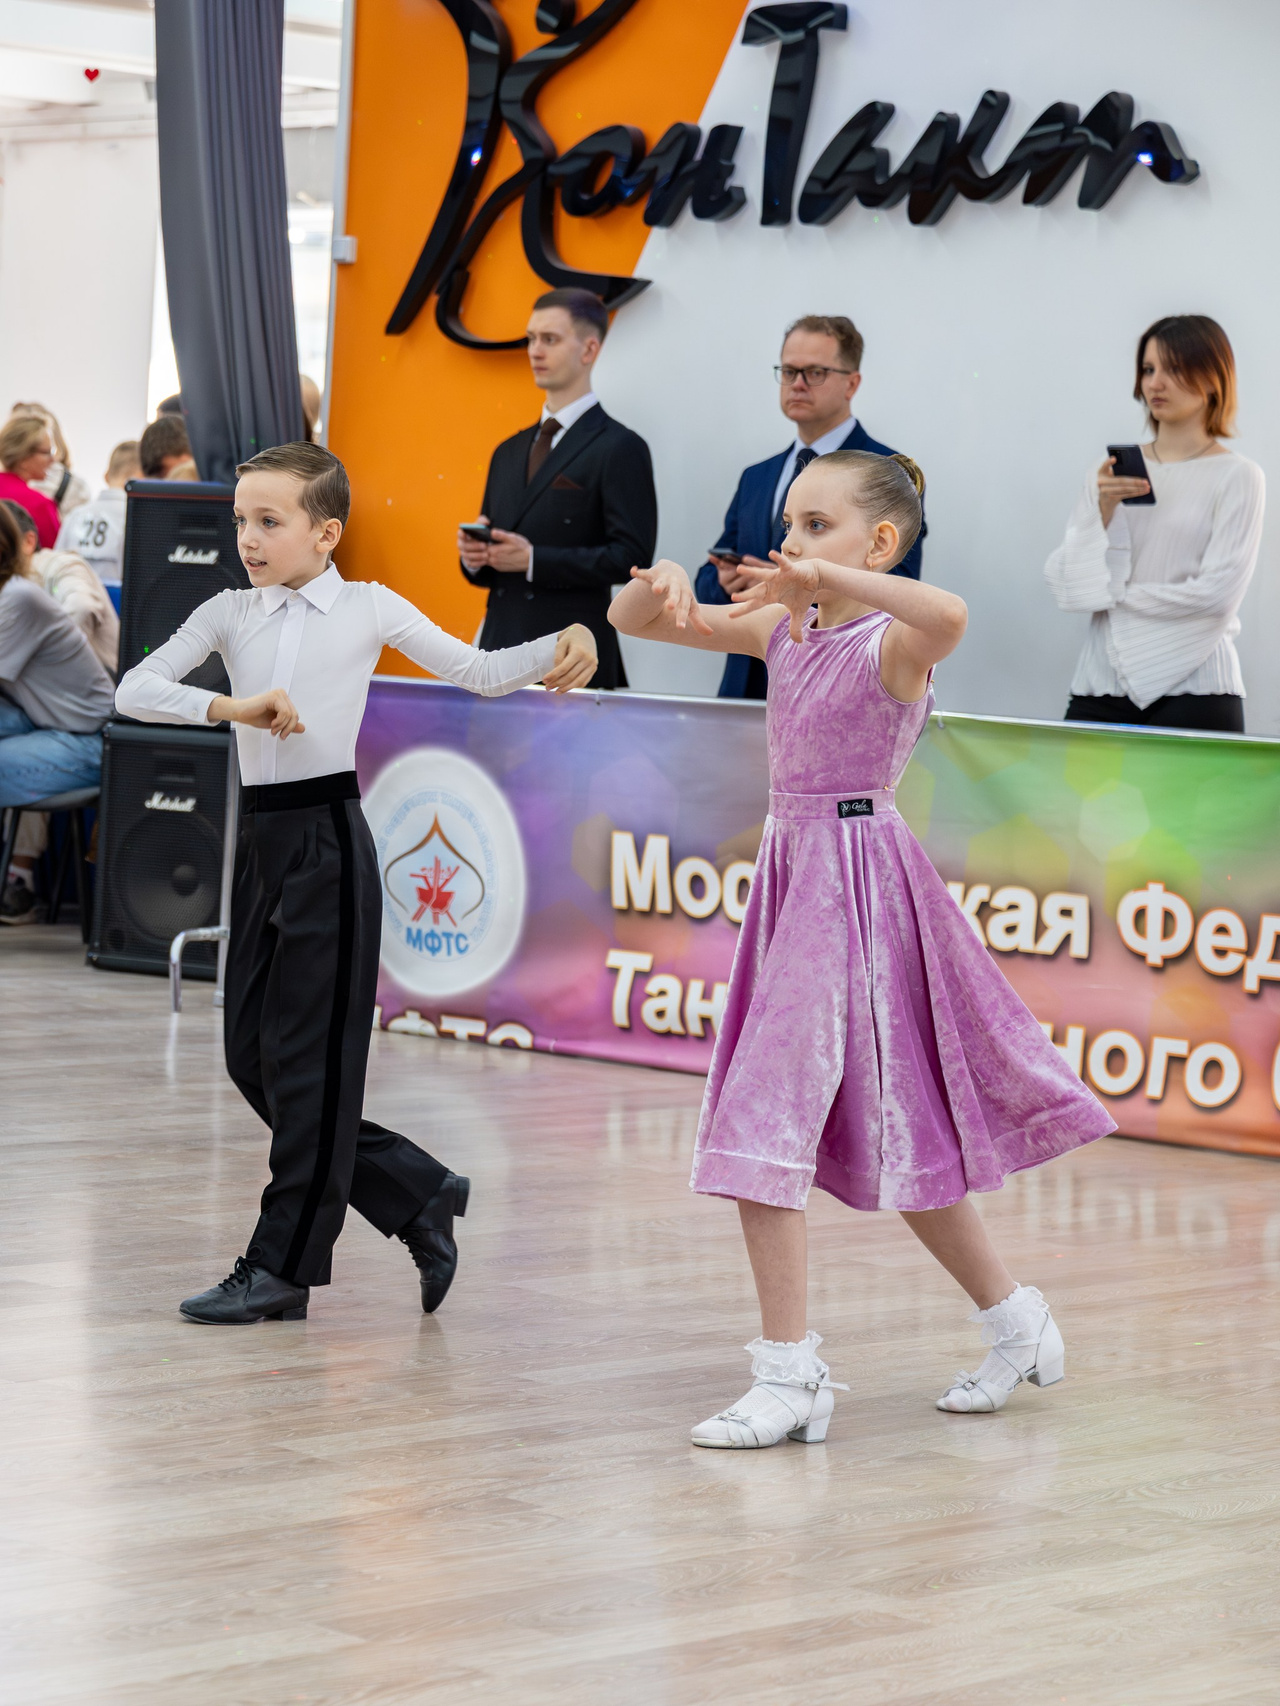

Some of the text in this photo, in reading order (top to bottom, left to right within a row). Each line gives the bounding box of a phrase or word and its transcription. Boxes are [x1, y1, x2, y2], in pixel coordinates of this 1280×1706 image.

[78, 519, 109, 547] 28
[611, 829, 1090, 959] Моская
[406, 926, 470, 957] МФТС
